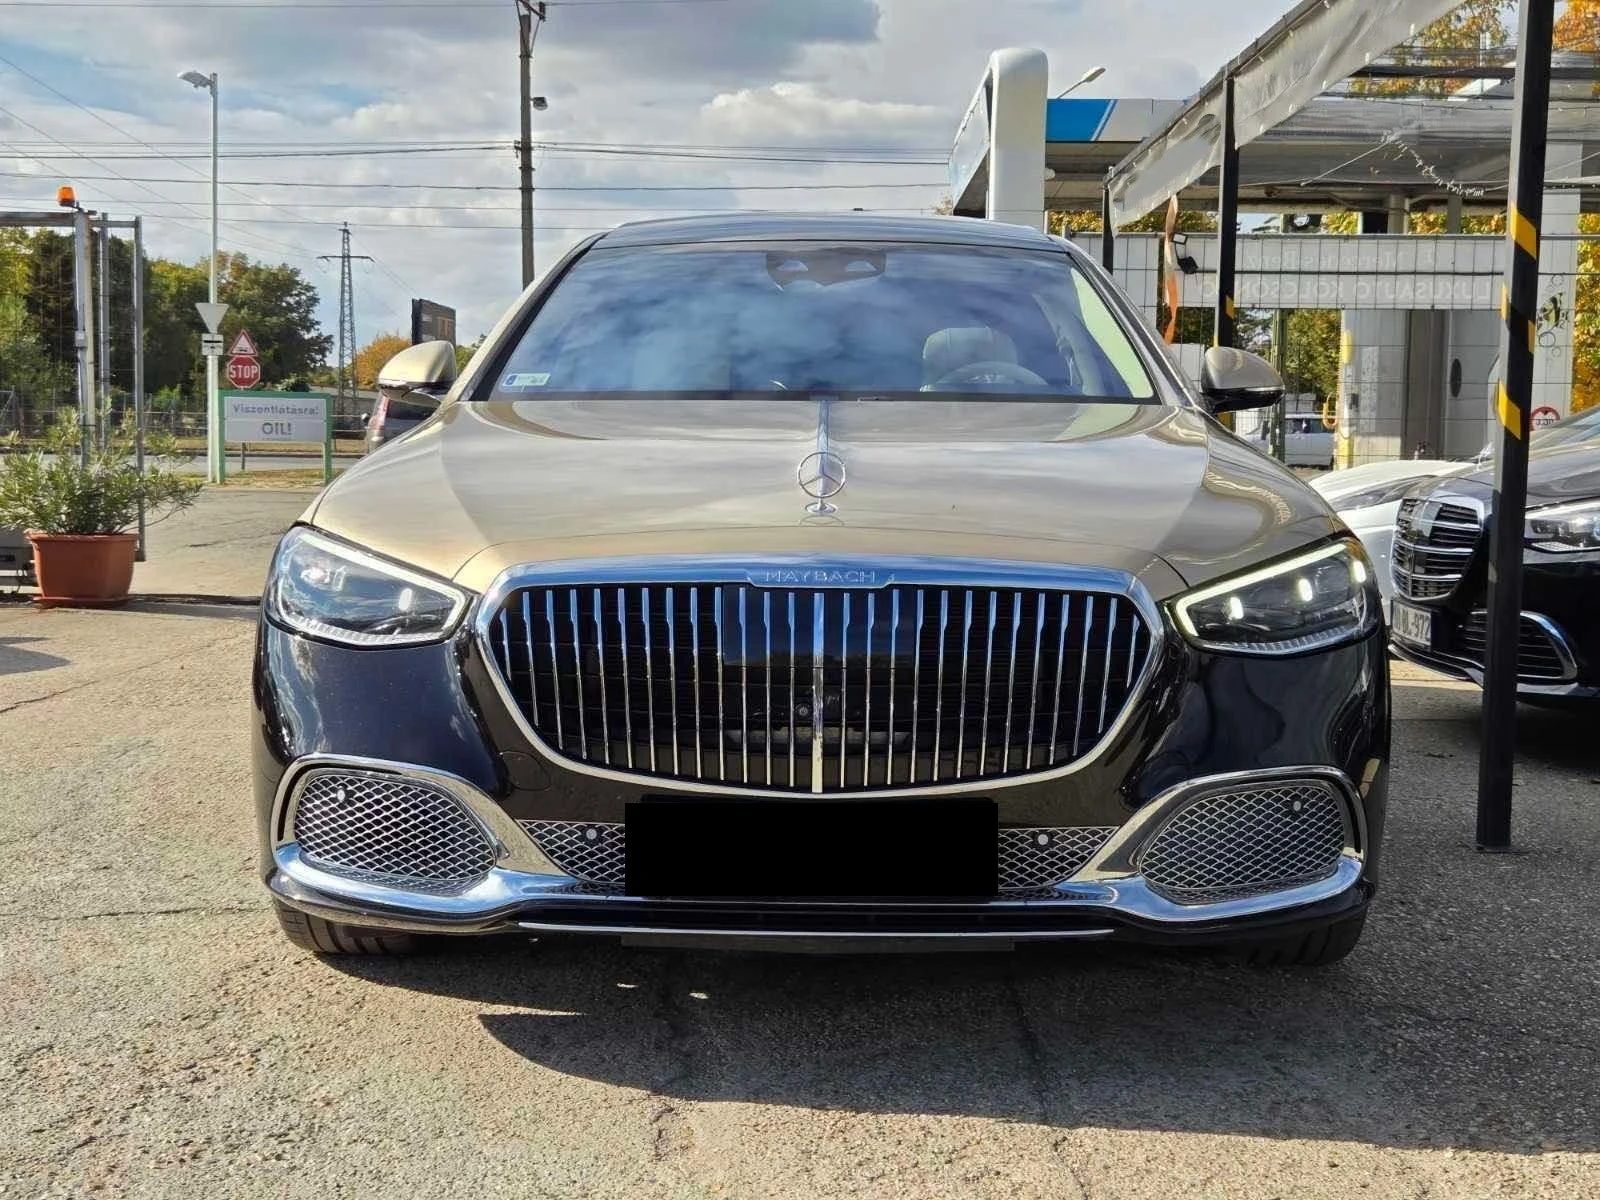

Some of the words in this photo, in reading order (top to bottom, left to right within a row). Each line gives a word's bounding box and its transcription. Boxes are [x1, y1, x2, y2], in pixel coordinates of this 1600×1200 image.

[230, 364, 258, 378] STOP
[262, 422, 292, 436] OIL!
[765, 569, 876, 583] MAYBACH
